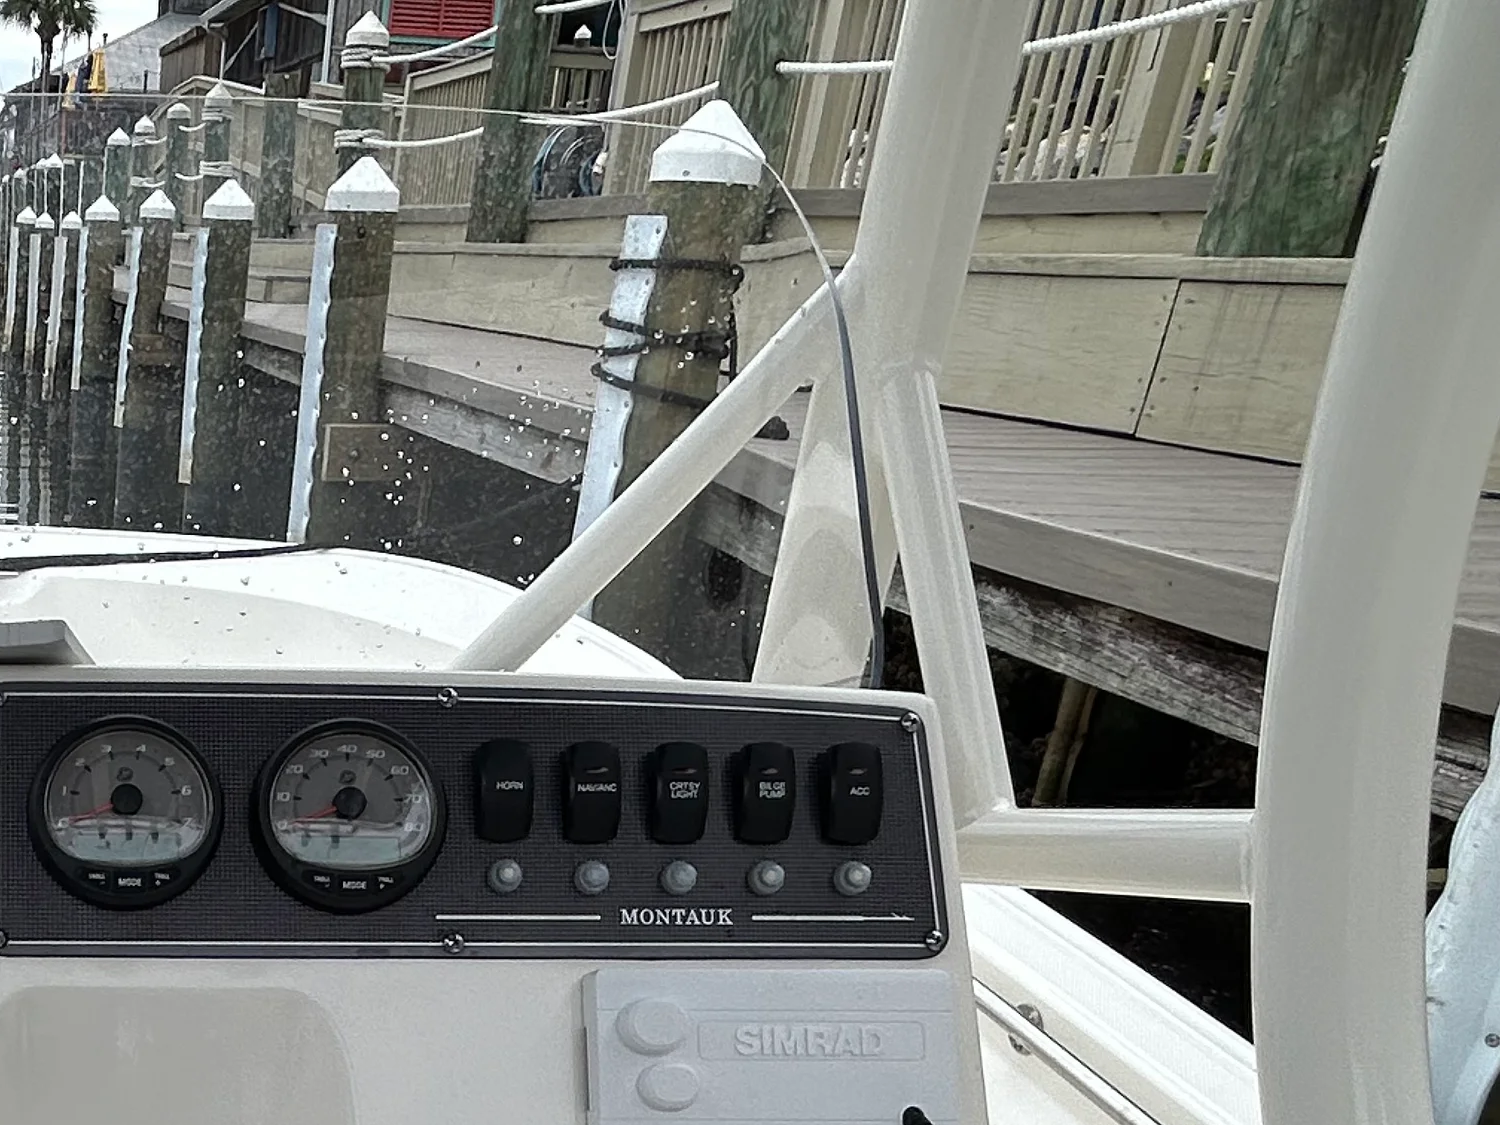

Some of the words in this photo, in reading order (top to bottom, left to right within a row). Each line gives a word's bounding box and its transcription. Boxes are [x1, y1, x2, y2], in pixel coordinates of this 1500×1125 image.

[309, 750, 329, 758] 30
[337, 745, 358, 753] 40
[496, 781, 524, 790] HORN
[759, 789, 786, 799] PUMP
[850, 786, 870, 796] ACC
[277, 792, 291, 802] 10
[620, 908, 733, 925] MONTAUK
[734, 1024, 884, 1058] SIMRAD
